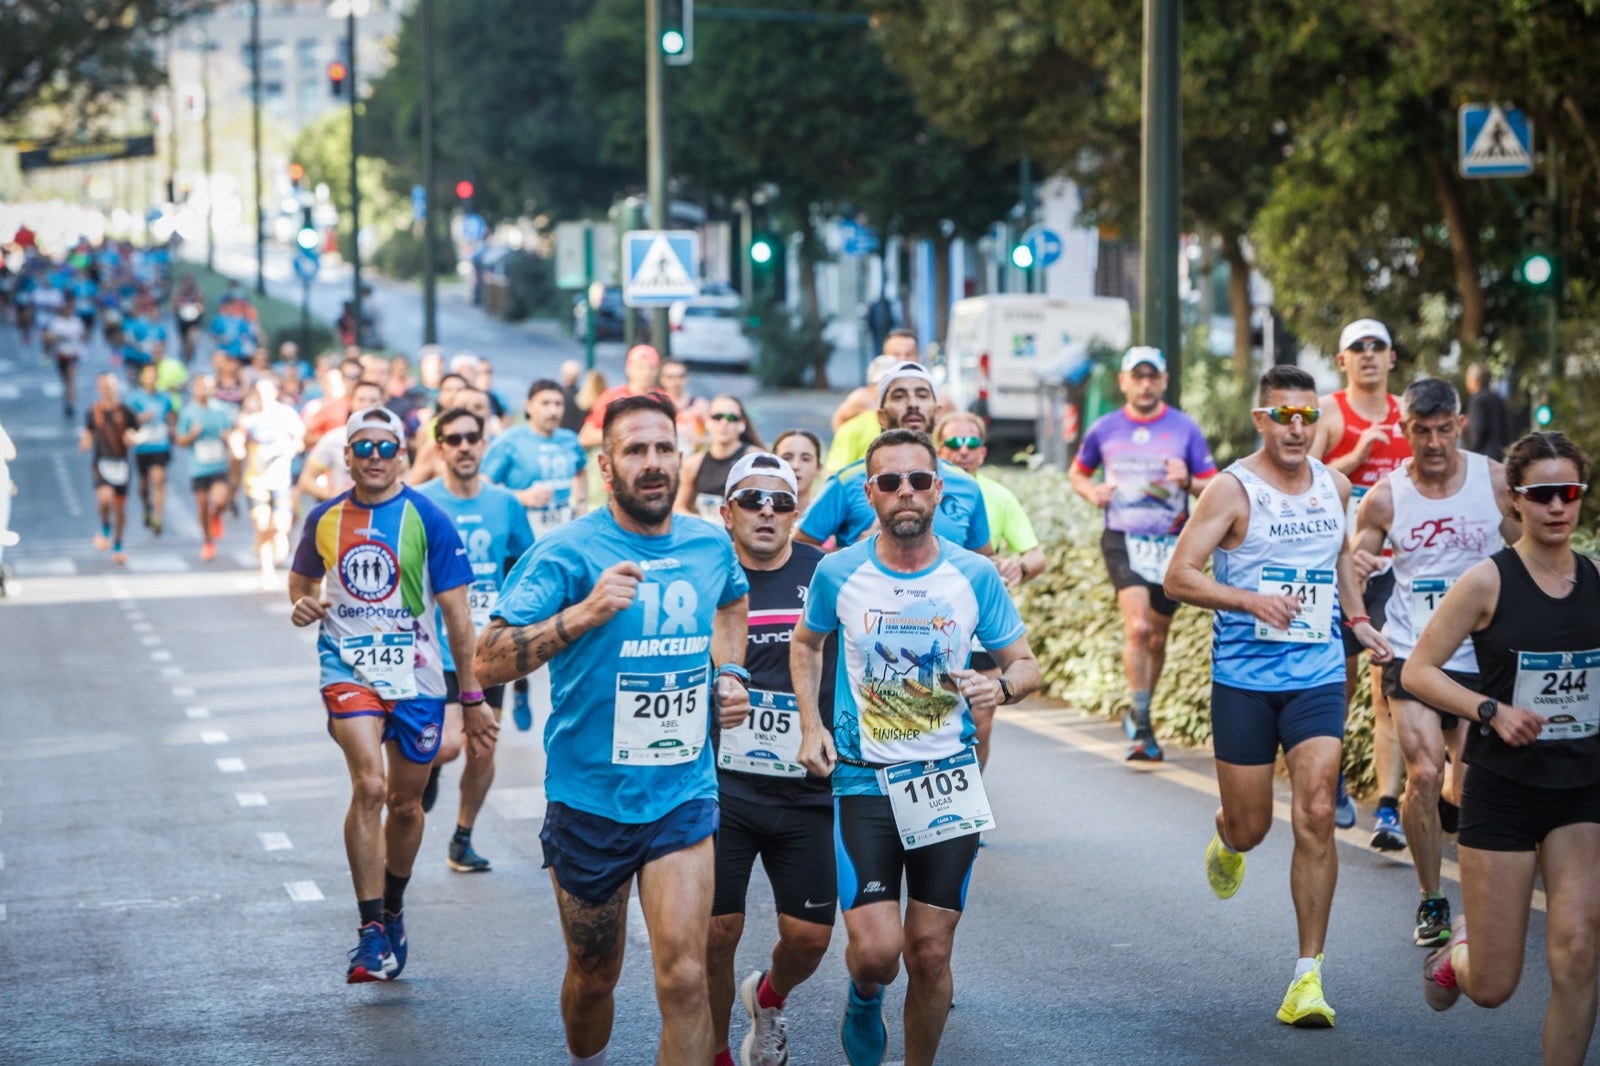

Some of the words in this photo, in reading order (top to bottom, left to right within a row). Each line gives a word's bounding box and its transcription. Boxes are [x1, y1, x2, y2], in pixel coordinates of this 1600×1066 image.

[1269, 518, 1339, 537] MARACENA
[1401, 517, 1456, 552] 525
[637, 579, 698, 636] 18
[354, 647, 404, 666] 2143
[618, 635, 709, 658] MARCELINO
[1541, 669, 1588, 696] 244
[633, 688, 698, 719] 2015
[660, 719, 679, 728] ABEL
[748, 708, 791, 734] 105
[872, 727, 921, 742] FINISHER
[904, 768, 969, 804] 1103
[929, 796, 953, 809] LUCAS
